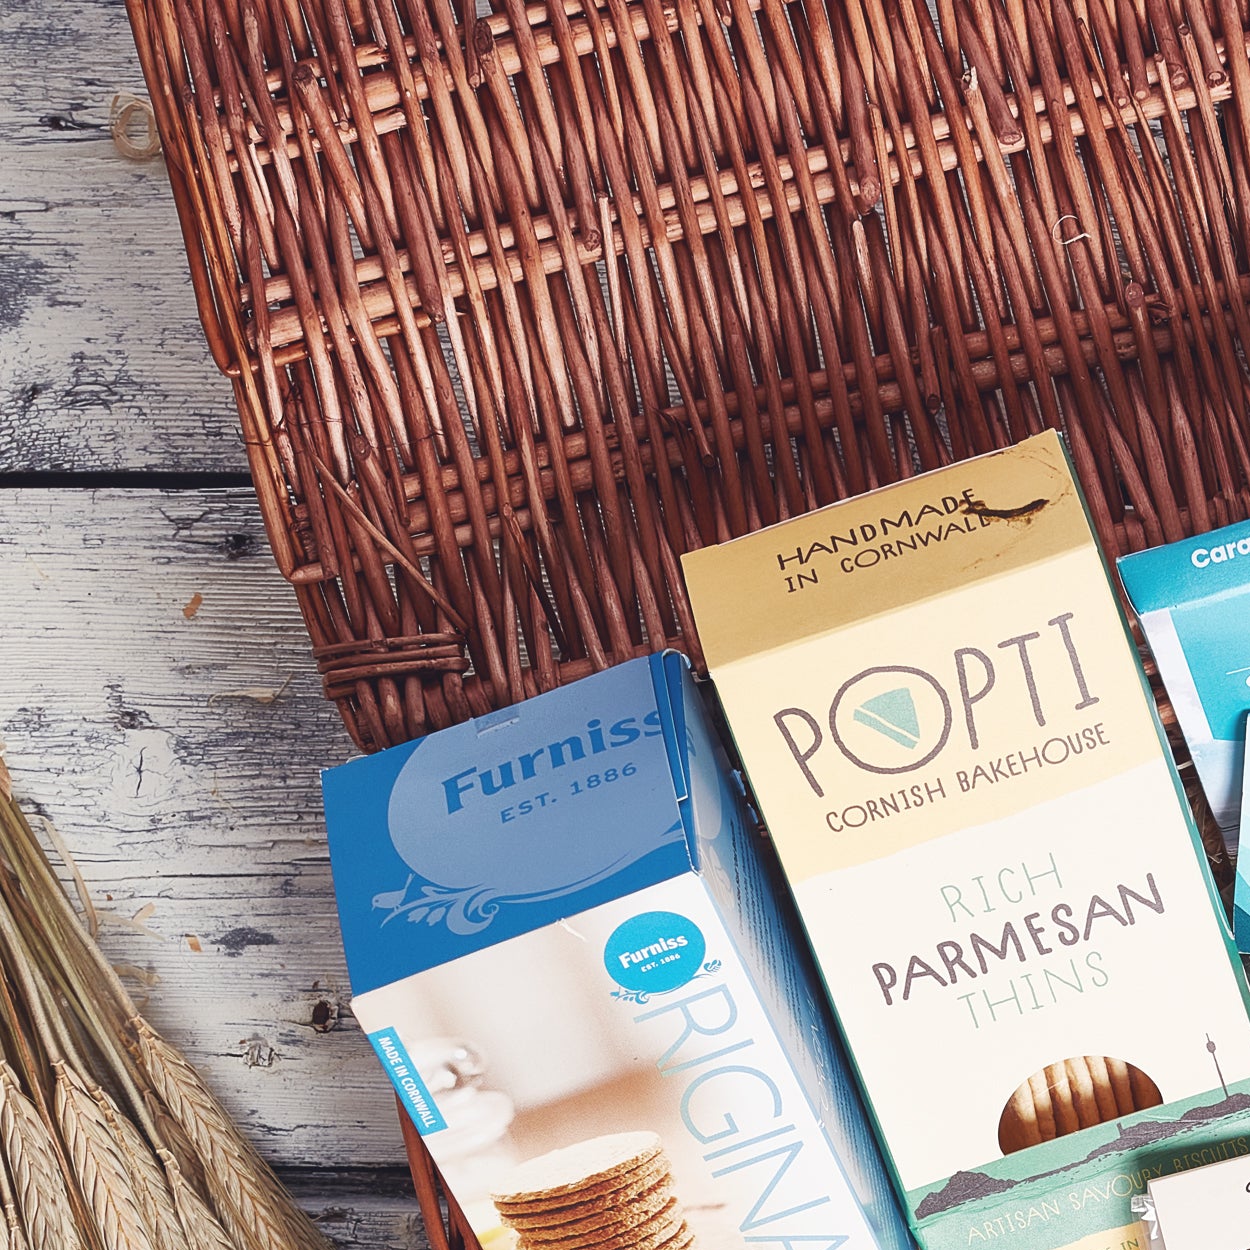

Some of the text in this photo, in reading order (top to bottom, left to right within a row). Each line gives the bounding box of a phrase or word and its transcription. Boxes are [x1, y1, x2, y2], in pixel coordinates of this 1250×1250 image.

[784, 514, 991, 593] IN CORNWALL
[773, 612, 1100, 798] POPTI
[500, 762, 637, 824] EST. 1886
[825, 722, 1111, 833] CORNISH BAKEHOUSE
[939, 852, 1063, 923] RICH
[618, 935, 689, 969] Furniss
[872, 872, 1165, 1006] PARMESAN
[957, 951, 1110, 1029] THINS
[378, 1036, 437, 1128] MADE IN CORNWALL
[967, 1136, 1250, 1246] ARTISAN SAVOURY BISCUITS
